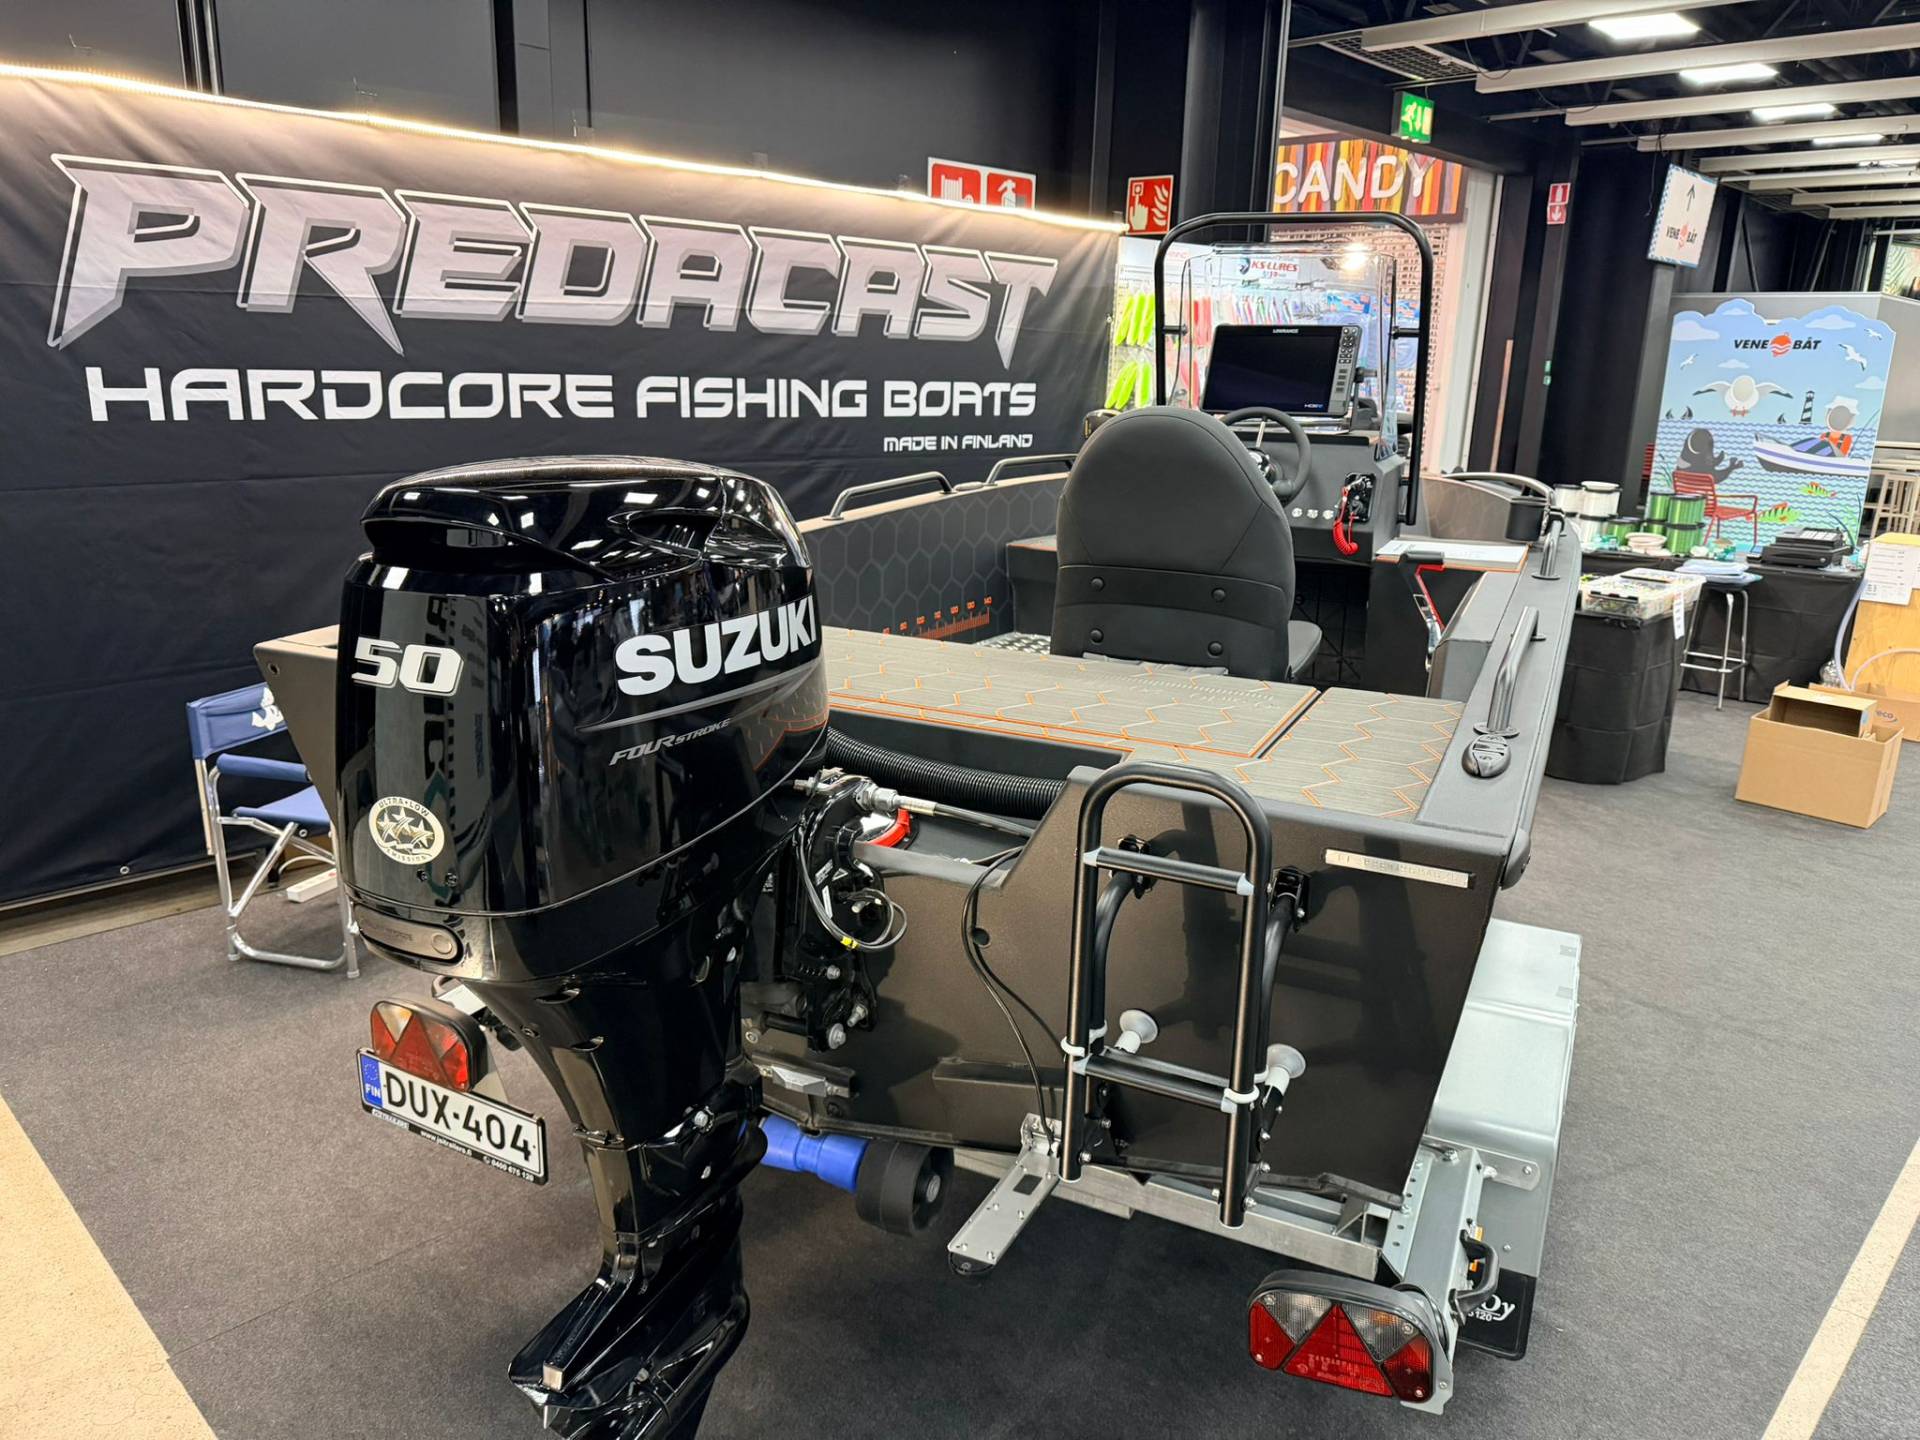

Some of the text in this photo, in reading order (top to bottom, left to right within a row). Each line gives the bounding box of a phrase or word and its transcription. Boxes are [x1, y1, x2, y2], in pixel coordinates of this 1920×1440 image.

[1275, 153, 1434, 204] CANDY
[47, 152, 1058, 370] PREDACAST
[1734, 336, 1821, 350] VENE BÅT
[85, 366, 1037, 422] HARDCORE FISHING BOATS
[883, 433, 1032, 453] MADE IN FINLAND
[351, 637, 464, 696] 50
[614, 596, 816, 696] SUZUKI
[378, 797, 429, 816] ULTRA LOW
[365, 1083, 381, 1099] FIN
[385, 1071, 532, 1162] DUX-404
